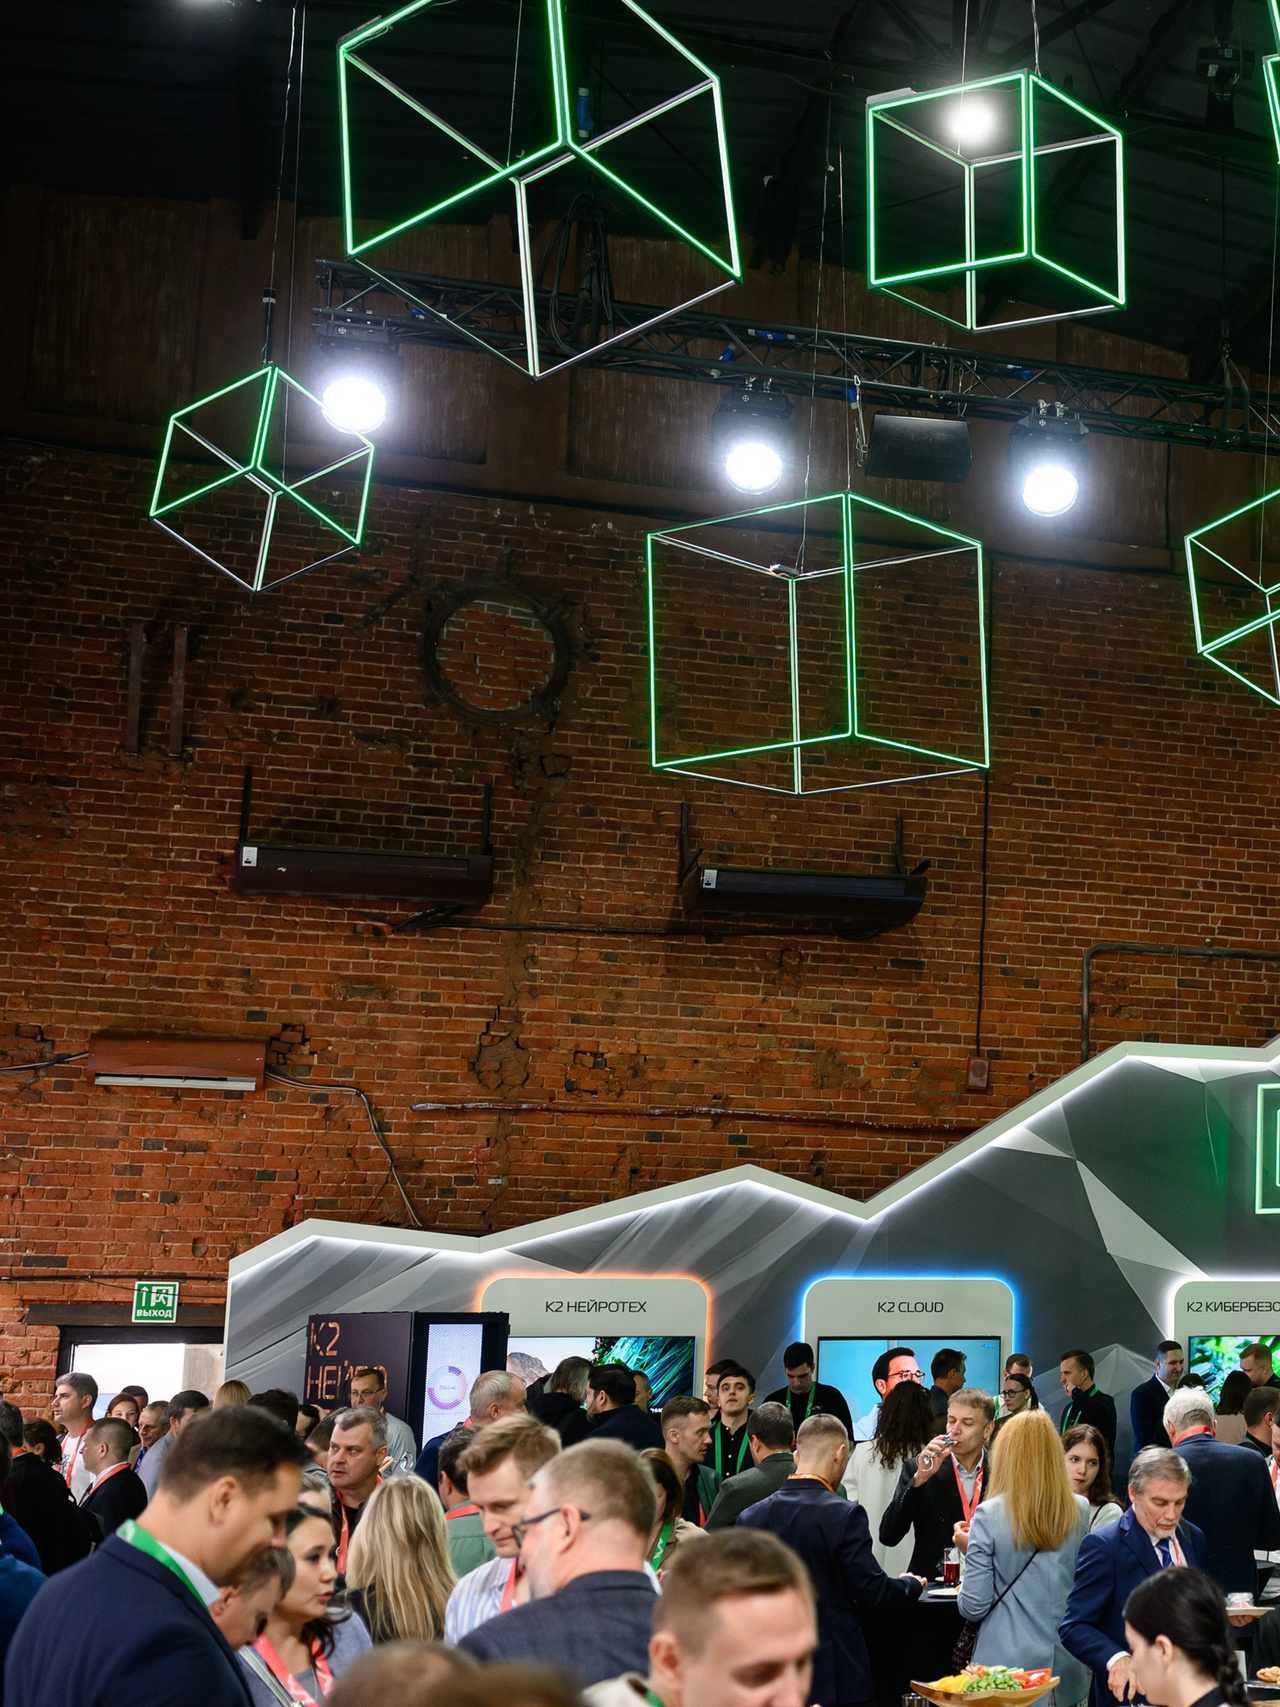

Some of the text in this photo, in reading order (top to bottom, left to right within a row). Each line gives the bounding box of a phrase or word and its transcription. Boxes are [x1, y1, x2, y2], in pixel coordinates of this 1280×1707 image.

[566, 1299, 647, 1313] НЕЙРОТЕХ
[877, 1301, 944, 1313] K2 CLOUD
[136, 1309, 173, 1318] ВЫХОД
